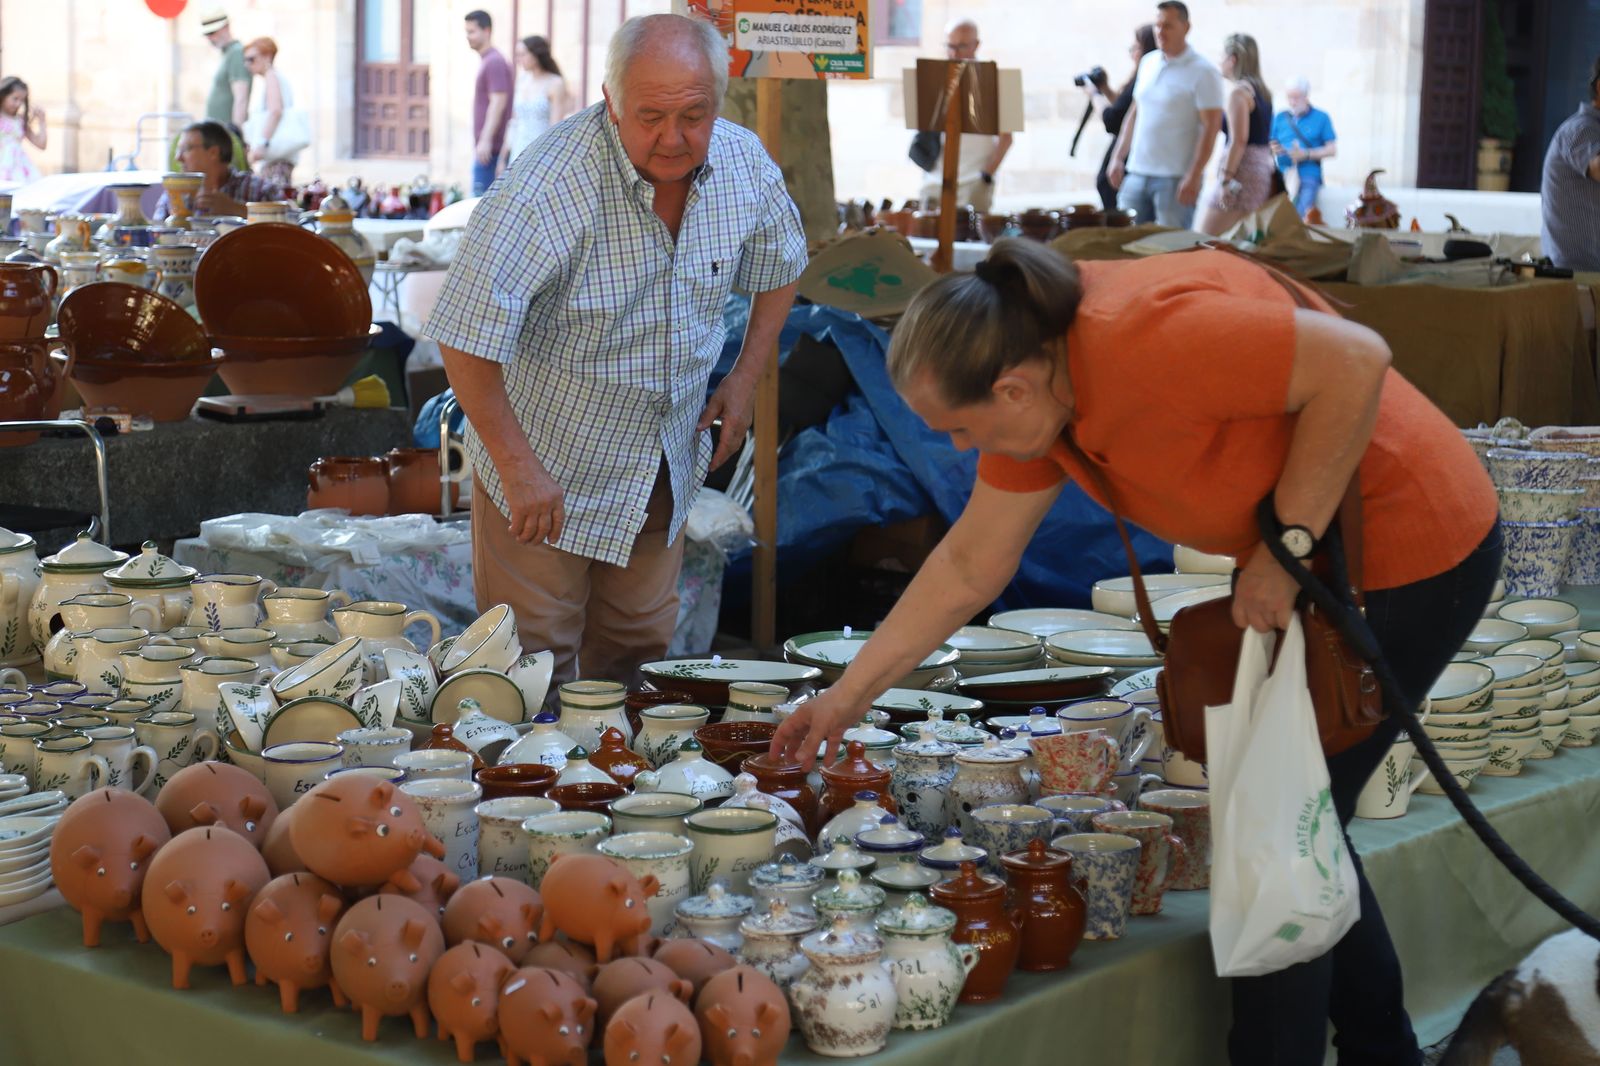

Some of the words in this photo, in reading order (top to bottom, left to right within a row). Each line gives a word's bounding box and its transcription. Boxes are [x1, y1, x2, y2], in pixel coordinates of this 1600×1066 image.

[752, 22, 782, 32] MANUEL
[783, 23, 811, 33] CARLOS
[1297, 797, 1319, 858] MATERIAL
[856, 992, 882, 1014] Sal
